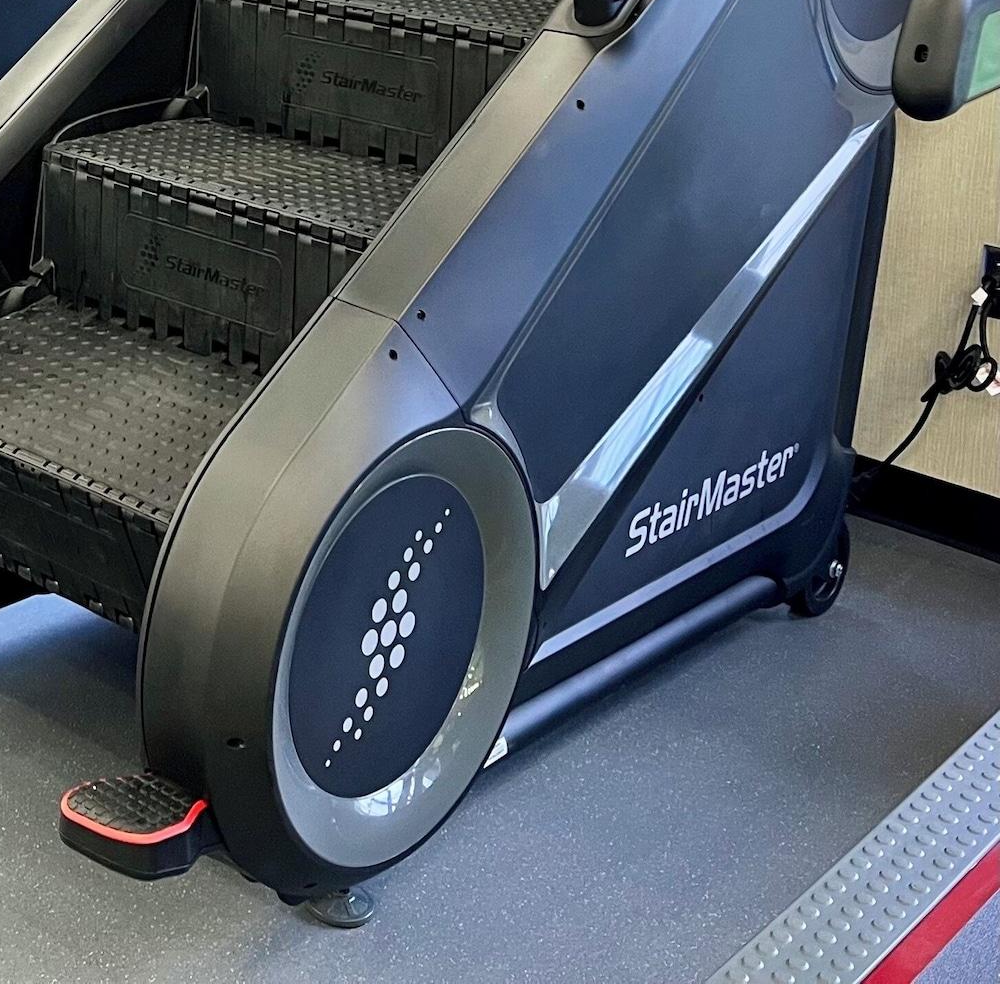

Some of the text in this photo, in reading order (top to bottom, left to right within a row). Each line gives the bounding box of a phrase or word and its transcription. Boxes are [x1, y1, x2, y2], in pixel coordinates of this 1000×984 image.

[320, 70, 422, 103] StairMaster
[166, 255, 265, 295] StairMaster
[625, 445, 796, 558] StairMaster
